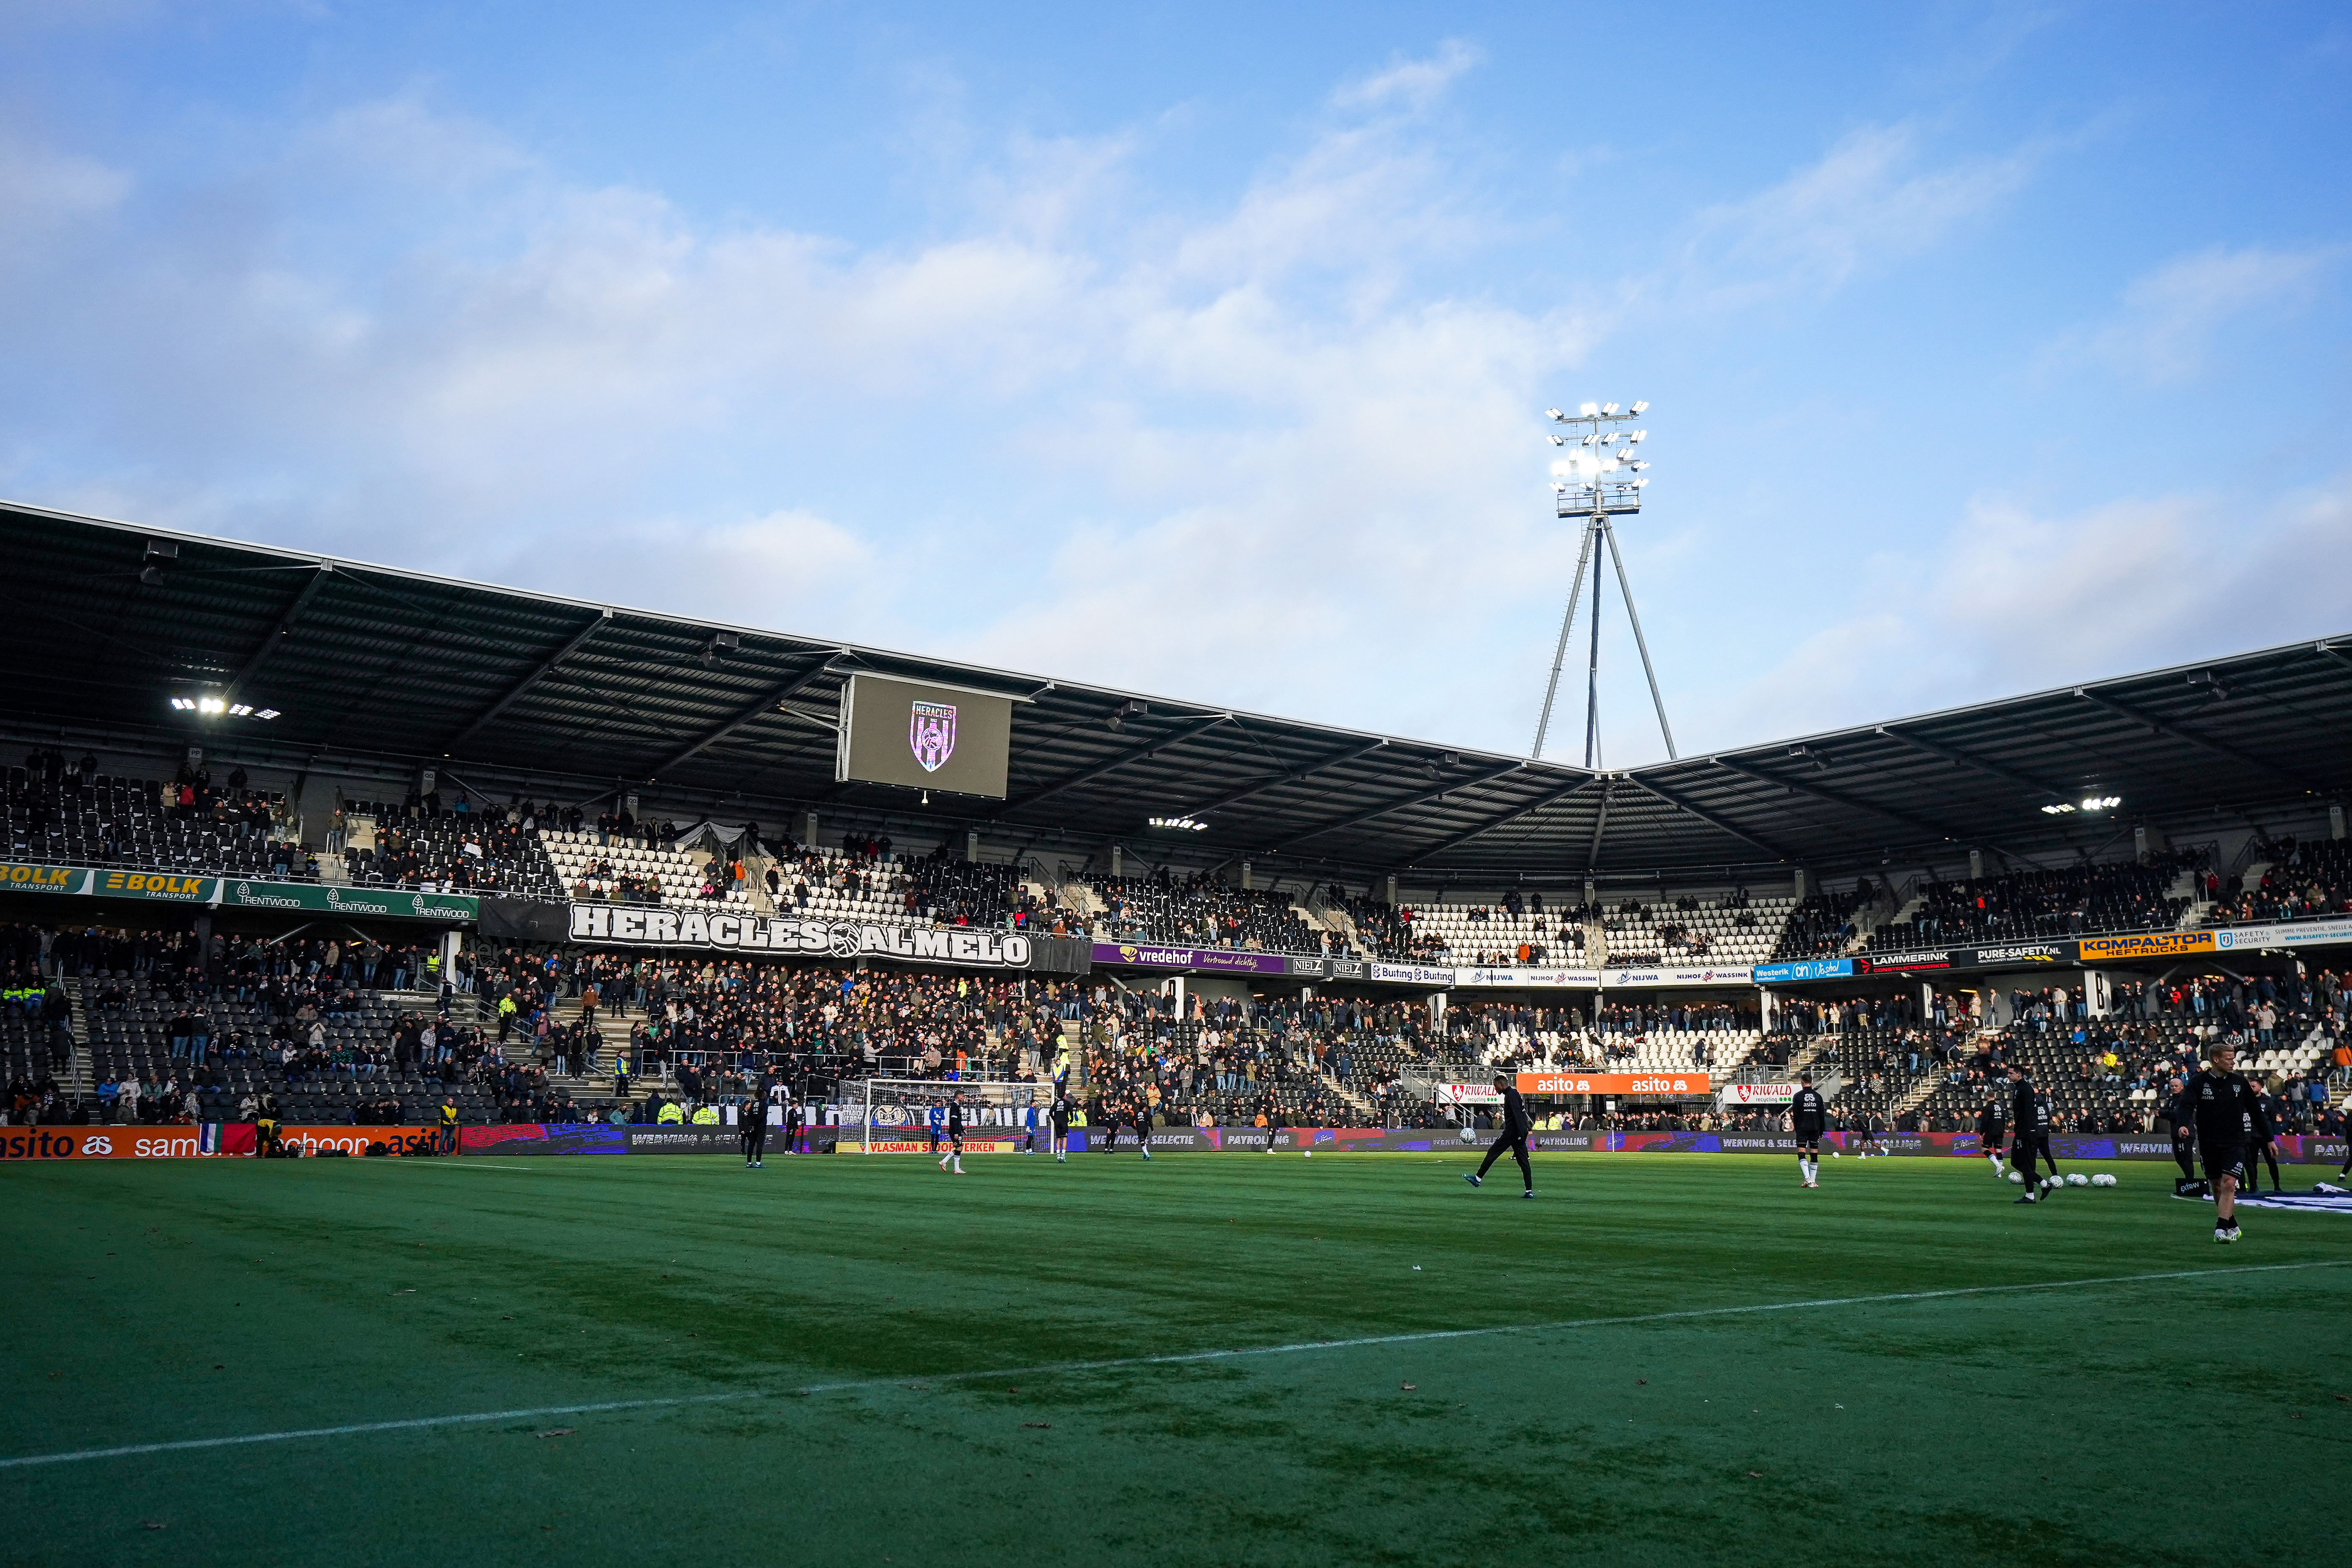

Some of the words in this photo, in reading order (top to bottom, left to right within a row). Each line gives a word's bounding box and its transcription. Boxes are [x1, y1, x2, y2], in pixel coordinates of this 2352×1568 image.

[916, 705, 953, 719] HERACLES
[10, 882, 65, 891] TRANSPORT
[127, 874, 203, 894] BOLK
[146, 891, 196, 900] TRANSPORT
[239, 894, 300, 907] TRENTWOOD
[328, 901, 387, 913] TRENTWOOD
[413, 906, 469, 918] TRENTWOOD
[571, 904, 830, 951] HERACLES
[860, 924, 1029, 964] ALMELO
[2084, 933, 2212, 951] KOMPACTOR
[1978, 946, 2061, 960] PURE-SAFETY.NL
[2106, 945, 2188, 956] HEFTRUCKS
[1139, 949, 1193, 965] vredehof
[1873, 952, 1949, 966] LAMMERINK
[1295, 960, 1322, 971] NIELZ
[1335, 962, 1361, 974] NIELZ
[1874, 963, 1950, 973] CONSTRUCTIEWERKEN
[1382, 968, 1412, 981] Buiting
[1424, 970, 1453, 984] Buiting
[1756, 968, 1789, 977] Westerik
[1537, 1076, 1573, 1091] asito
[1632, 1076, 1670, 1092] asito
[1752, 1085, 1792, 1096] RIWALD
[1091, 1135, 1139, 1145] WEVING
[1151, 1135, 1194, 1145] SELECTIE
[1540, 1137, 1588, 1145] PAYROLLING
[1723, 1139, 1765, 1148] WERVING
[1767, 1139, 1775, 1148] &
[870, 1143, 917, 1152] VLASMAN
[2181, 1182, 2199, 1193] EXTRAN
